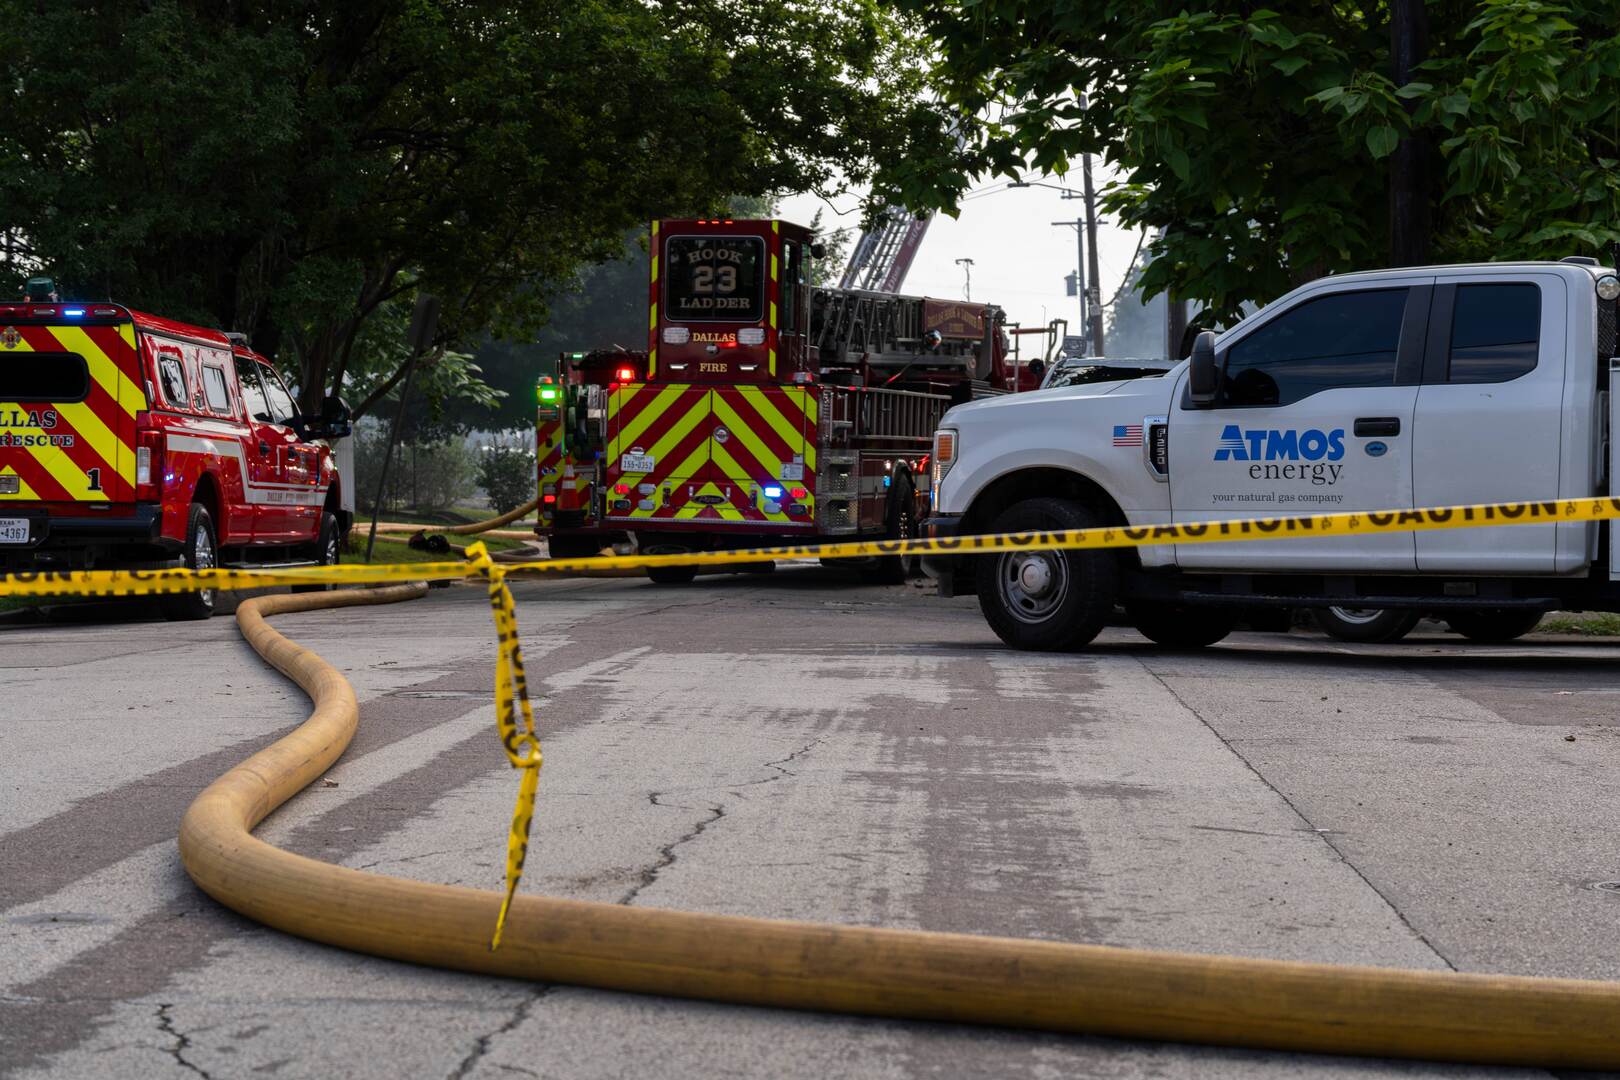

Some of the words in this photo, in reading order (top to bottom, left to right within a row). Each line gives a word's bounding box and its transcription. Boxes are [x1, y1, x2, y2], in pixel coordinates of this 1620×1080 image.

[687, 248, 743, 264] HOOK
[695, 265, 737, 292] 23
[680, 298, 751, 309] LADDER
[692, 332, 736, 342] DALLAS
[699, 363, 728, 373] FIRE
[0, 434, 75, 447] RESCUE
[1213, 425, 1345, 461] ATMOS
[87, 468, 103, 491] 1
[1249, 462, 1344, 486] energy
[1212, 494, 1235, 504] your
[1238, 491, 1275, 502] natural
[1278, 494, 1295, 504] gas
[1297, 494, 1344, 505] company
